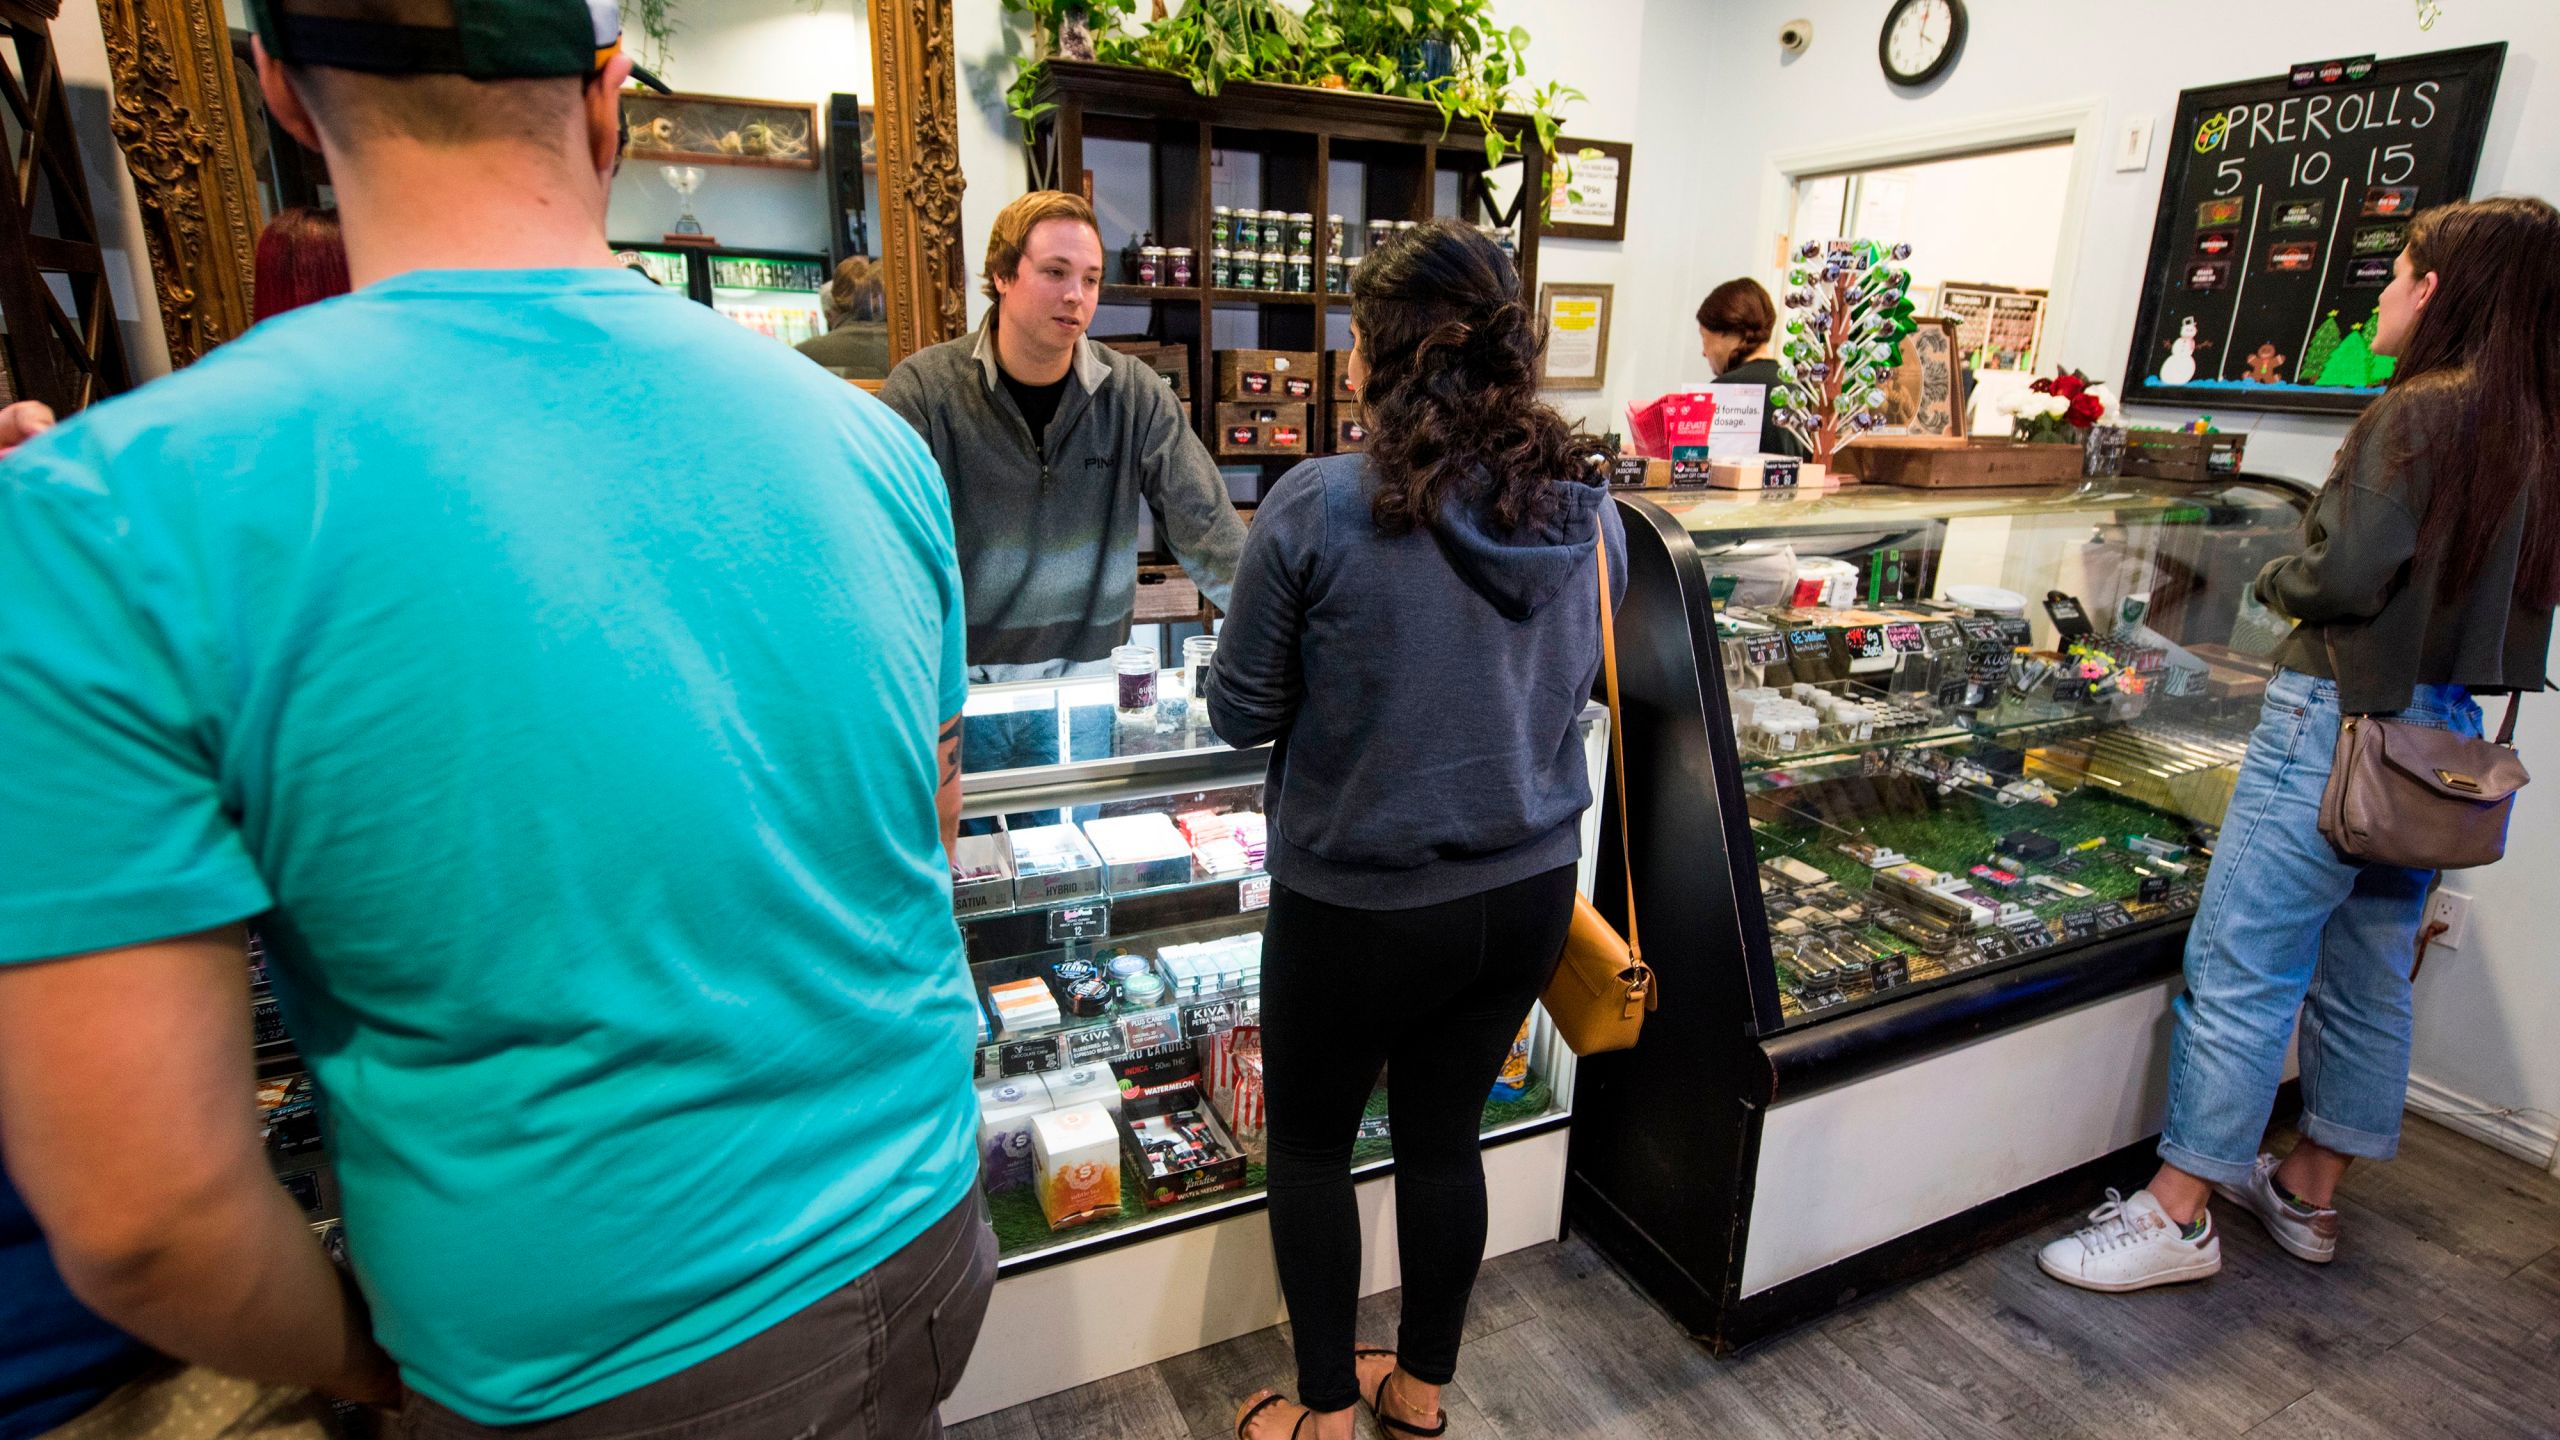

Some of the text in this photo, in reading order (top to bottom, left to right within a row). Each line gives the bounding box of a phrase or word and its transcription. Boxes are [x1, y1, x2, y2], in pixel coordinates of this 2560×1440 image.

[2320, 66, 2343, 78] SATIVA
[2346, 63, 2373, 75] HYBRID
[2221, 81, 2440, 152] PREROLLS
[2289, 150, 2332, 188] 10
[2366, 143, 2416, 187] 15
[2213, 157, 2246, 196] 5
[1583, 184, 1602, 195] 1996
[1722, 405, 1760, 415] formulas.
[1677, 421, 1708, 430] ELEVATE
[1714, 418, 1746, 428] dosage.
[1046, 883, 1078, 897] HYBRID
[1252, 879, 1271, 889] KIV
[955, 895, 987, 910] SATIVA
[1074, 926, 1082, 936] 12
[1193, 1005, 1227, 1019] KIVA
[1131, 1018, 1146, 1027] PLUS
[1146, 1013, 1171, 1024] CANDIES
[1191, 1014, 1230, 1027] PETRA MINTS
[1080, 1030, 1110, 1043] KIVA
[1011, 1051, 1036, 1059] CHOCOLATE
[1073, 1050, 1096, 1059] ESPRESSO
[1147, 1041, 1192, 1057] CANDIES
[1026, 1060, 1035, 1071] 12
[1124, 1064, 1149, 1076] INDICA
[1172, 1057, 1186, 1067] THC
[1144, 1079, 1195, 1096] WATERMELON
[1015, 1134, 1028, 1147] S
[1079, 1166, 1092, 1178] S
[1177, 1184, 1225, 1201] WATERMELON
